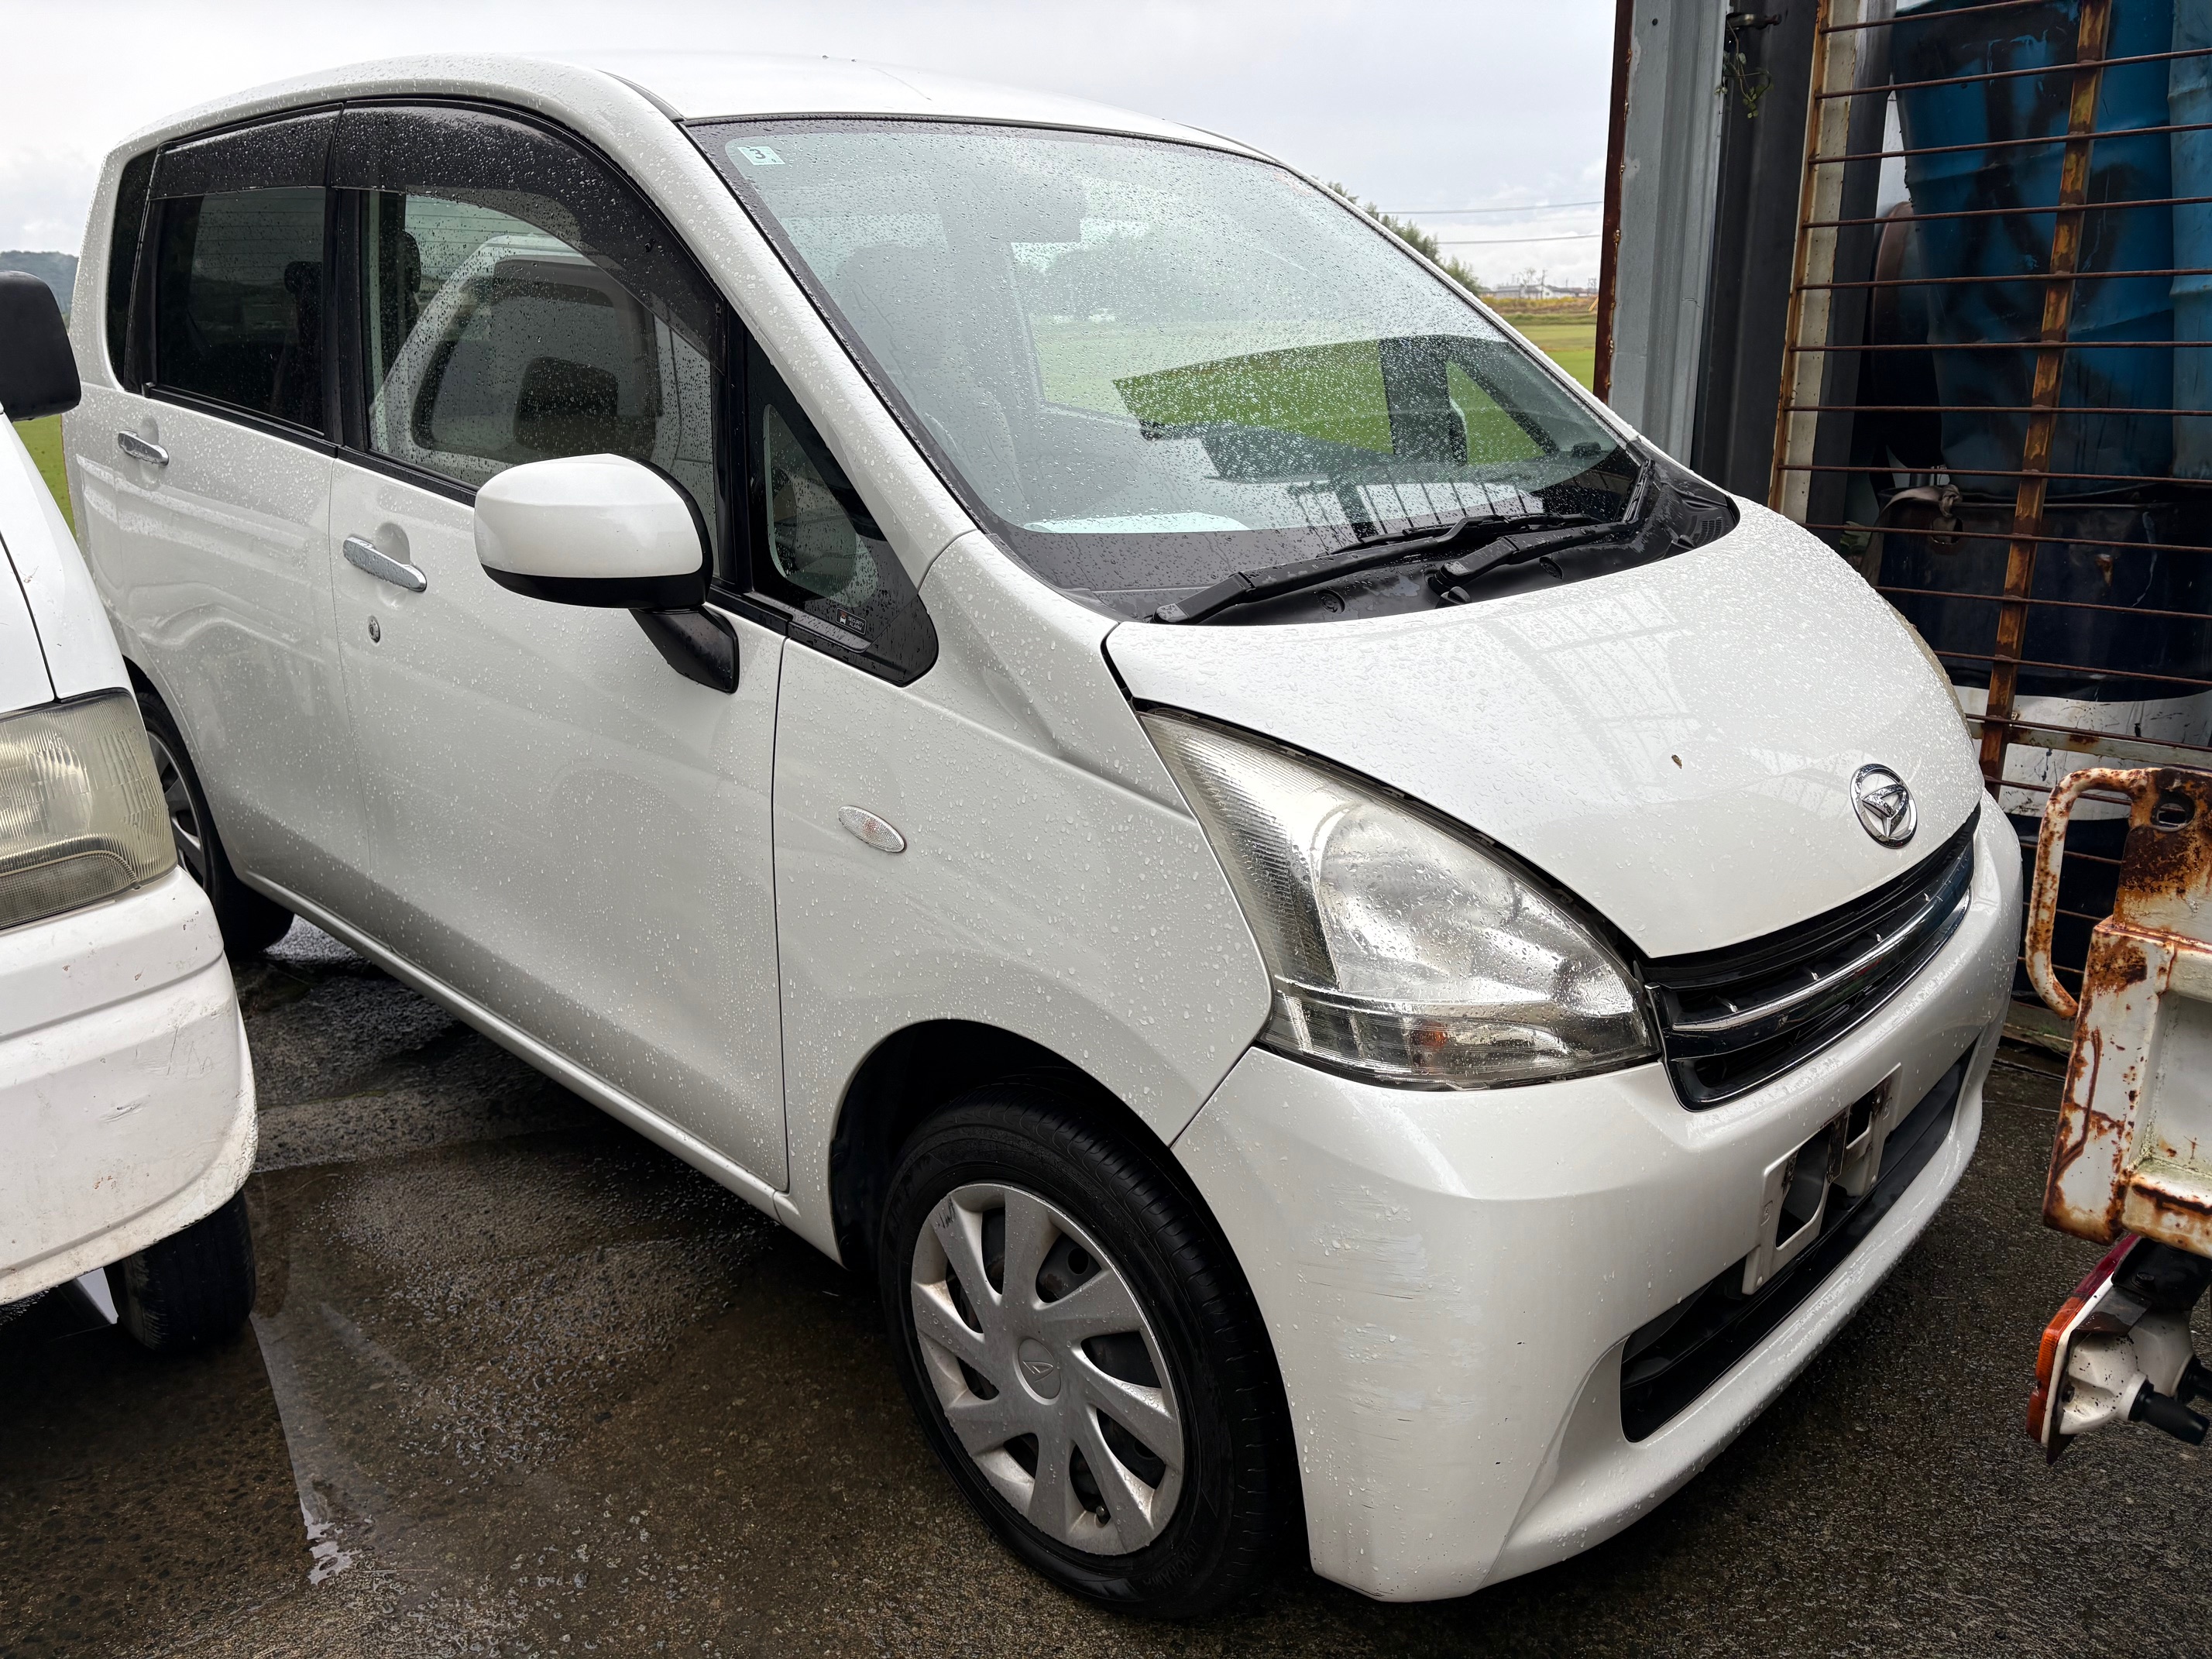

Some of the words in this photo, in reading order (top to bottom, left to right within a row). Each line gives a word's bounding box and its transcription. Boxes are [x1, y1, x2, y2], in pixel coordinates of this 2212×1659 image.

[749, 149, 766, 160] 3
[847, 616, 864, 627] SECURITY
[849, 622, 862, 631] ALARM
